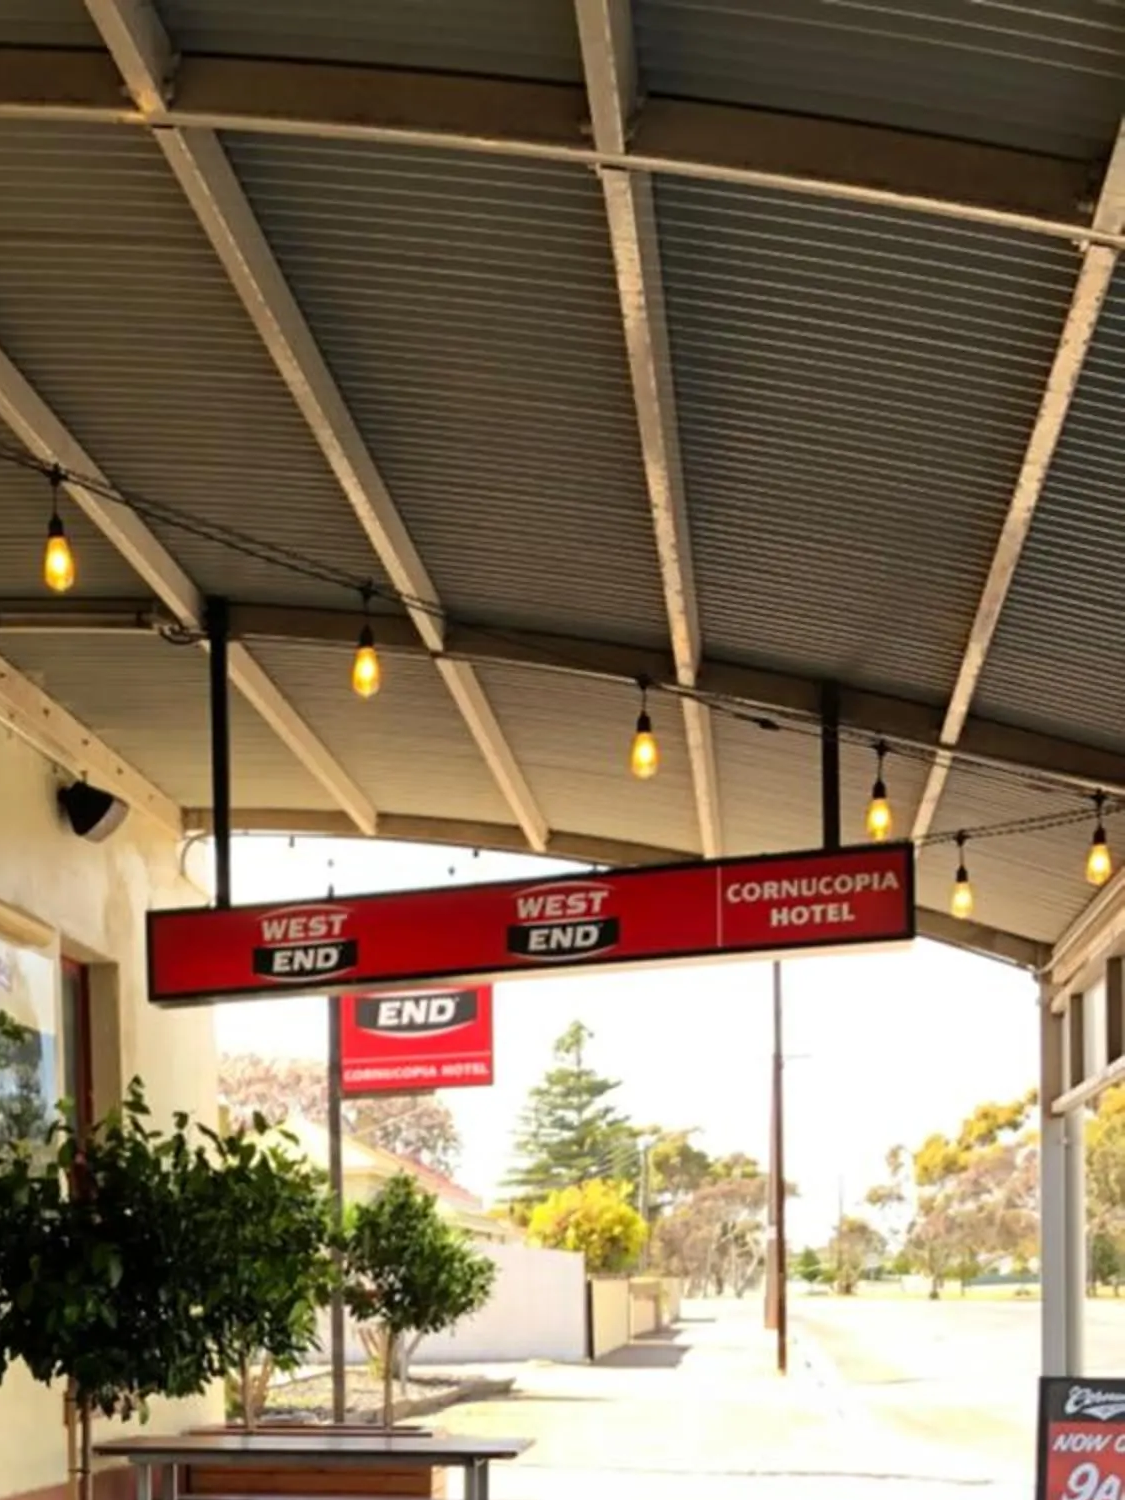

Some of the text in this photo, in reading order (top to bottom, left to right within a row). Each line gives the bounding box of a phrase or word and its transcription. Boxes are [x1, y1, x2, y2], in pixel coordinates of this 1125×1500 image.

[726, 871, 899, 903] CORNUCOPIA
[516, 890, 609, 919] WEST
[770, 903, 856, 927] HOTEL
[261, 913, 347, 941] WEST
[527, 924, 600, 952] END
[272, 946, 339, 973] END
[377, 997, 456, 1027] END
[1053, 1433, 1114, 1453] NOW
